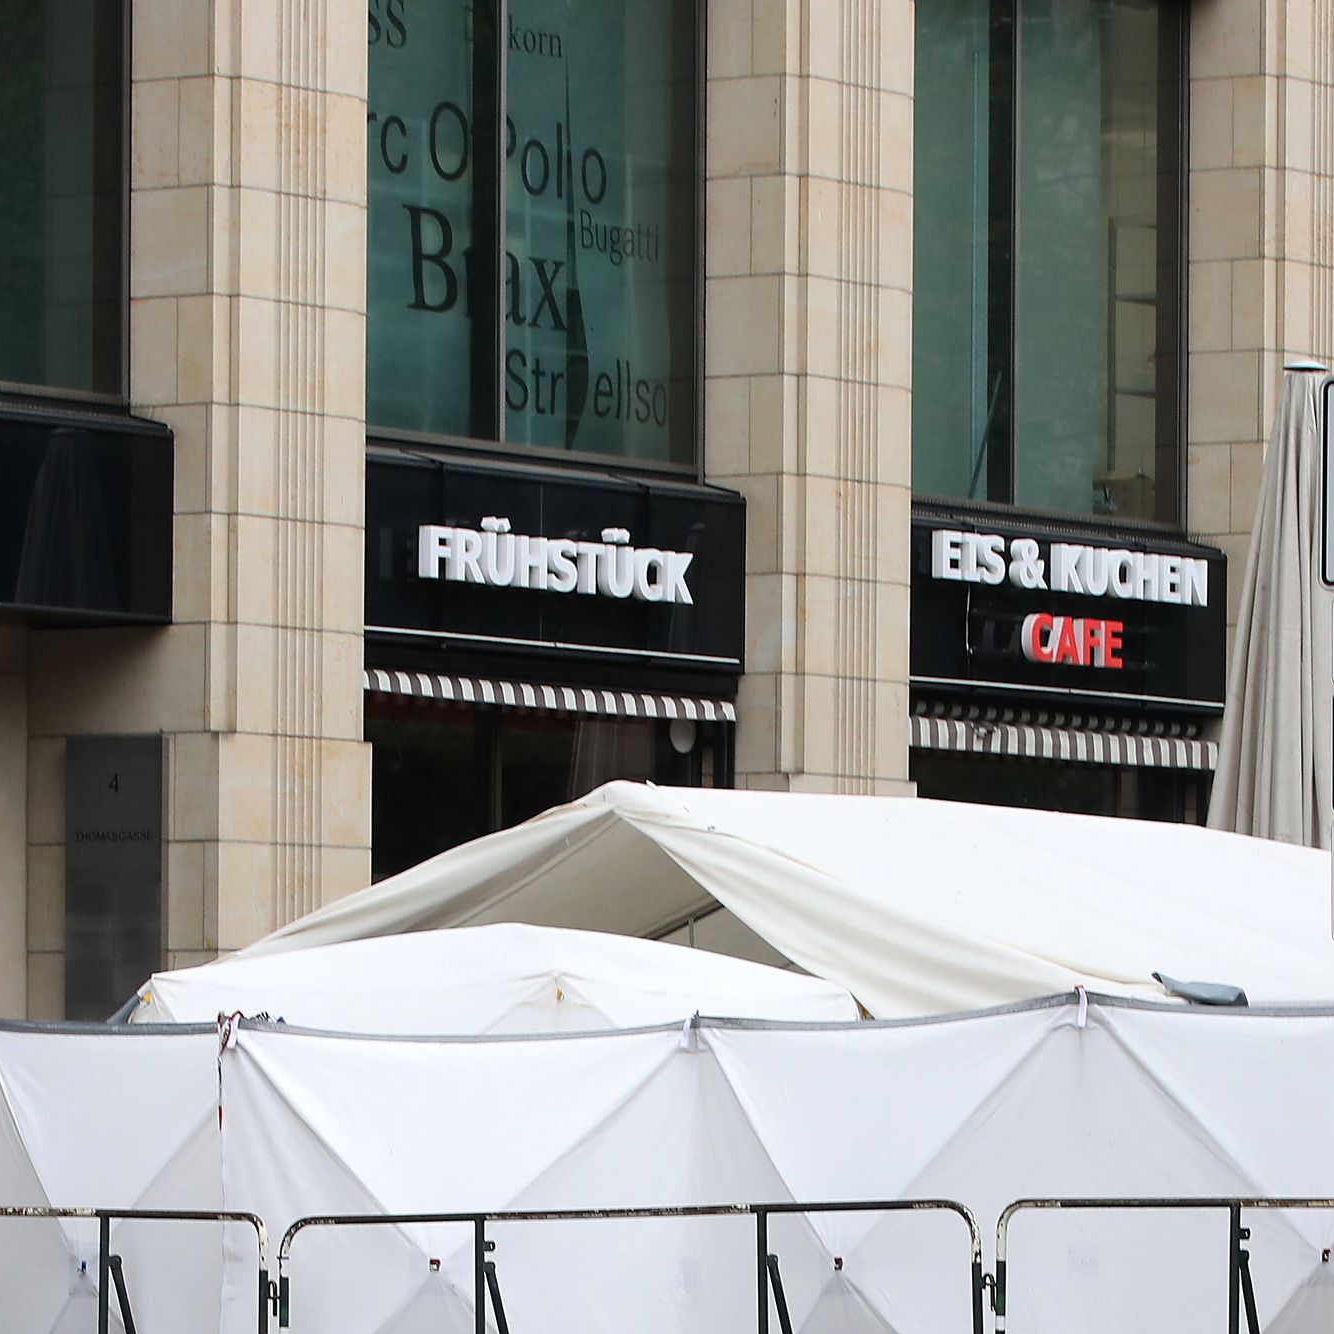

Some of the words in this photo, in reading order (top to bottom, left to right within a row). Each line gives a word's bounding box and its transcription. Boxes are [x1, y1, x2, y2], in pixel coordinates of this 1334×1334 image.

[580, 210, 660, 266] Bugatti
[403, 204, 570, 332] Bax
[418, 516, 694, 604] FRÜHSTÜCK
[932, 529, 1006, 585] EIS
[1009, 538, 1048, 590] &
[1050, 543, 1208, 607] KUCHEN
[1021, 612, 1124, 669] CAFE
[108, 773, 120, 792] 4
[75, 829, 154, 842] THOMASGASSE
